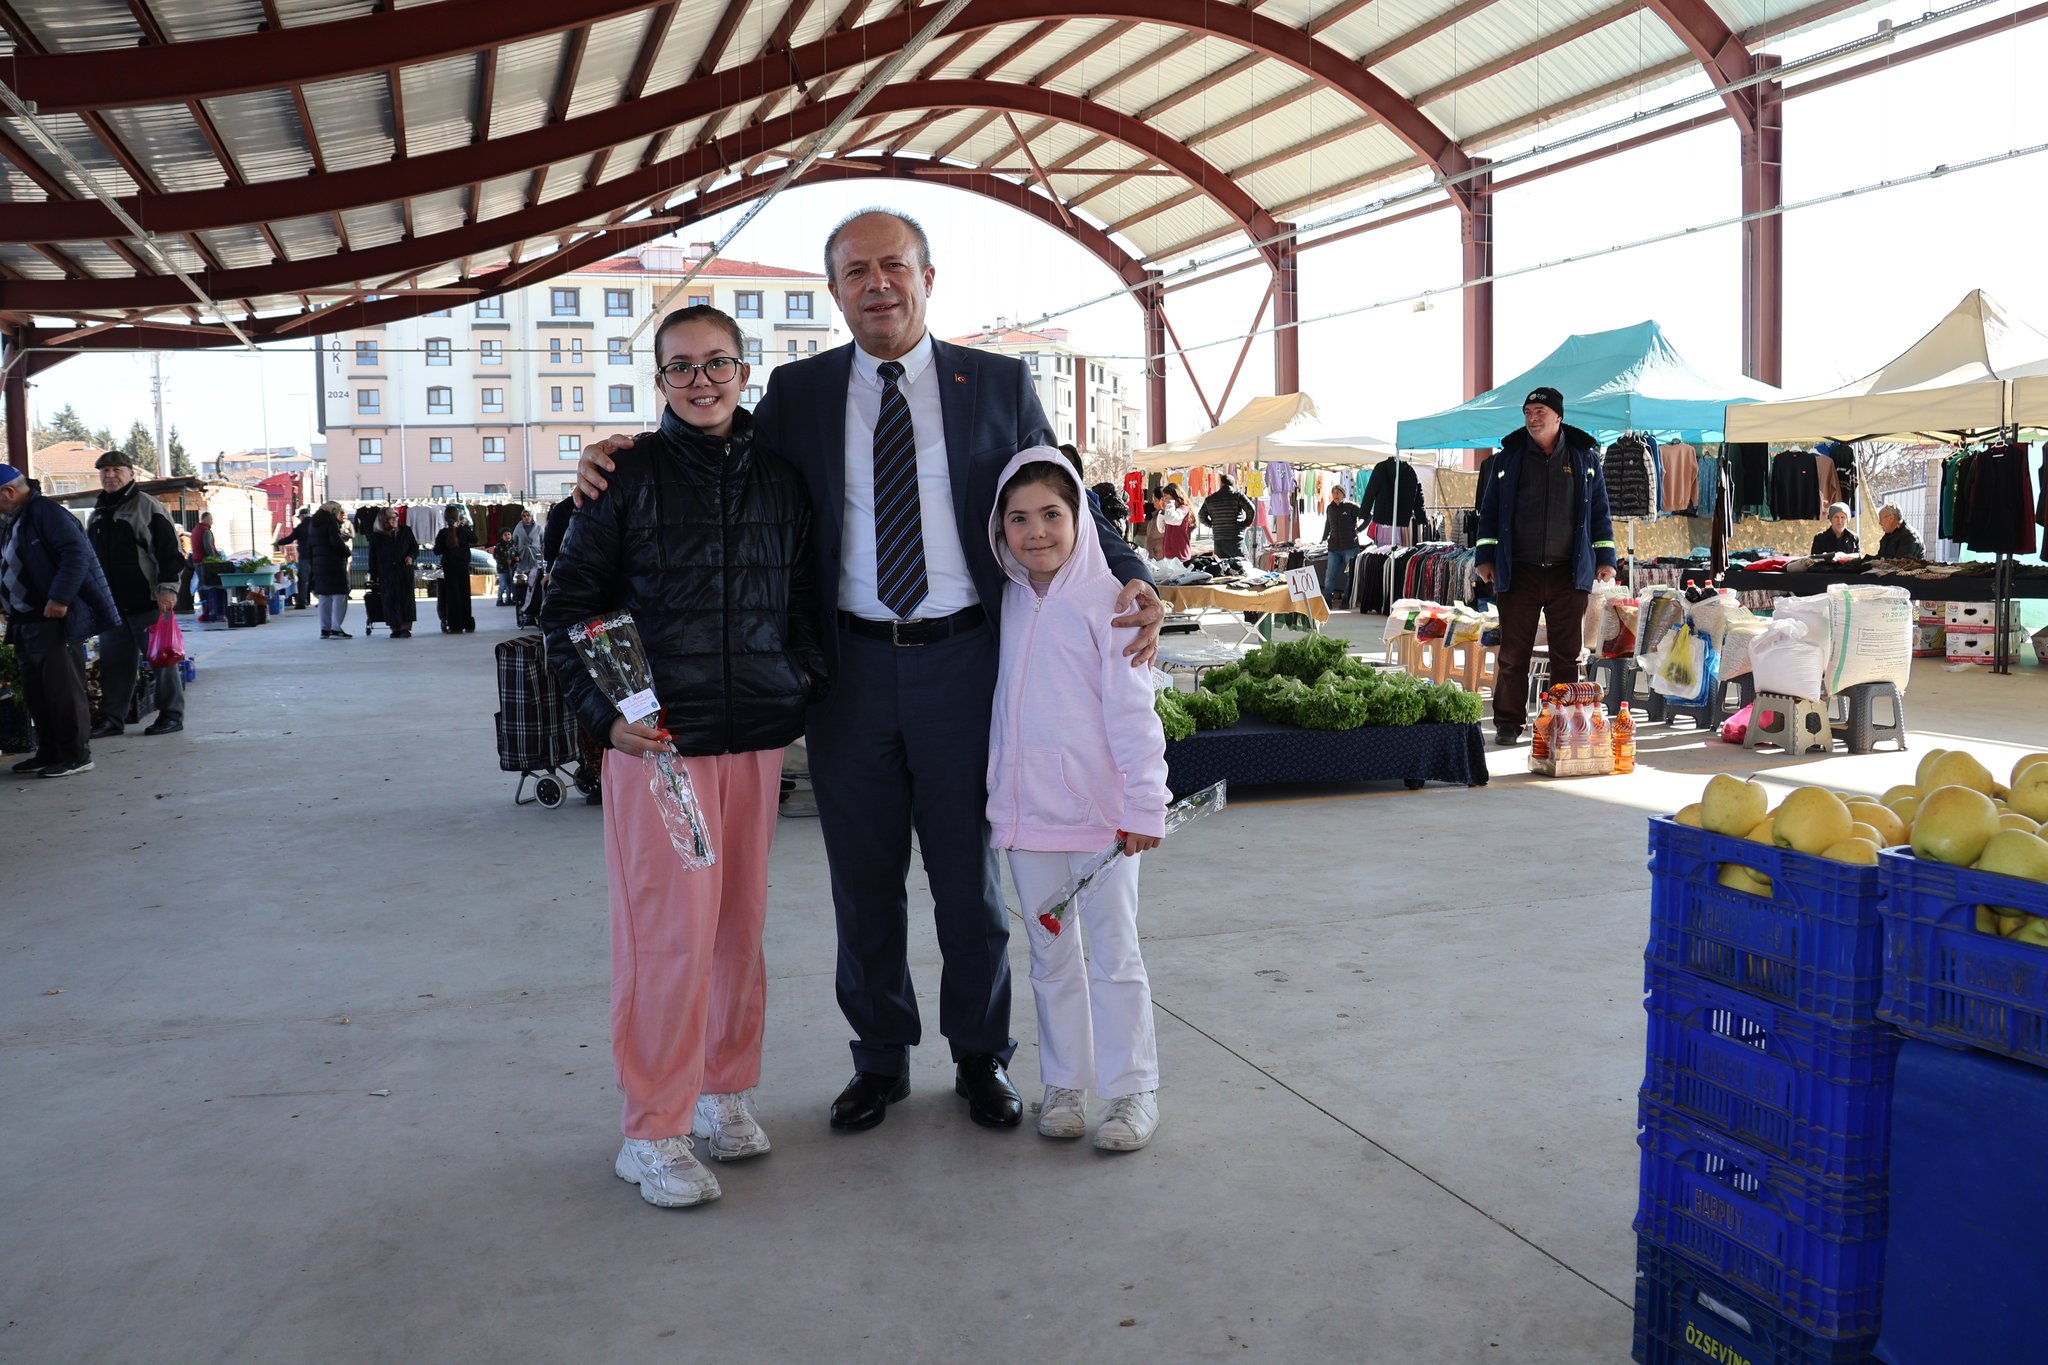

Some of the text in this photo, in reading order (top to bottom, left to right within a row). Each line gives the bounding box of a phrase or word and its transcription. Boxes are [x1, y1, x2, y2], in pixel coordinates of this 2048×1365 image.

[327, 391, 349, 399] 2024
[1695, 1188, 1742, 1234] HARPUT
[1685, 1321, 1751, 1365] ÖZSEVİN
